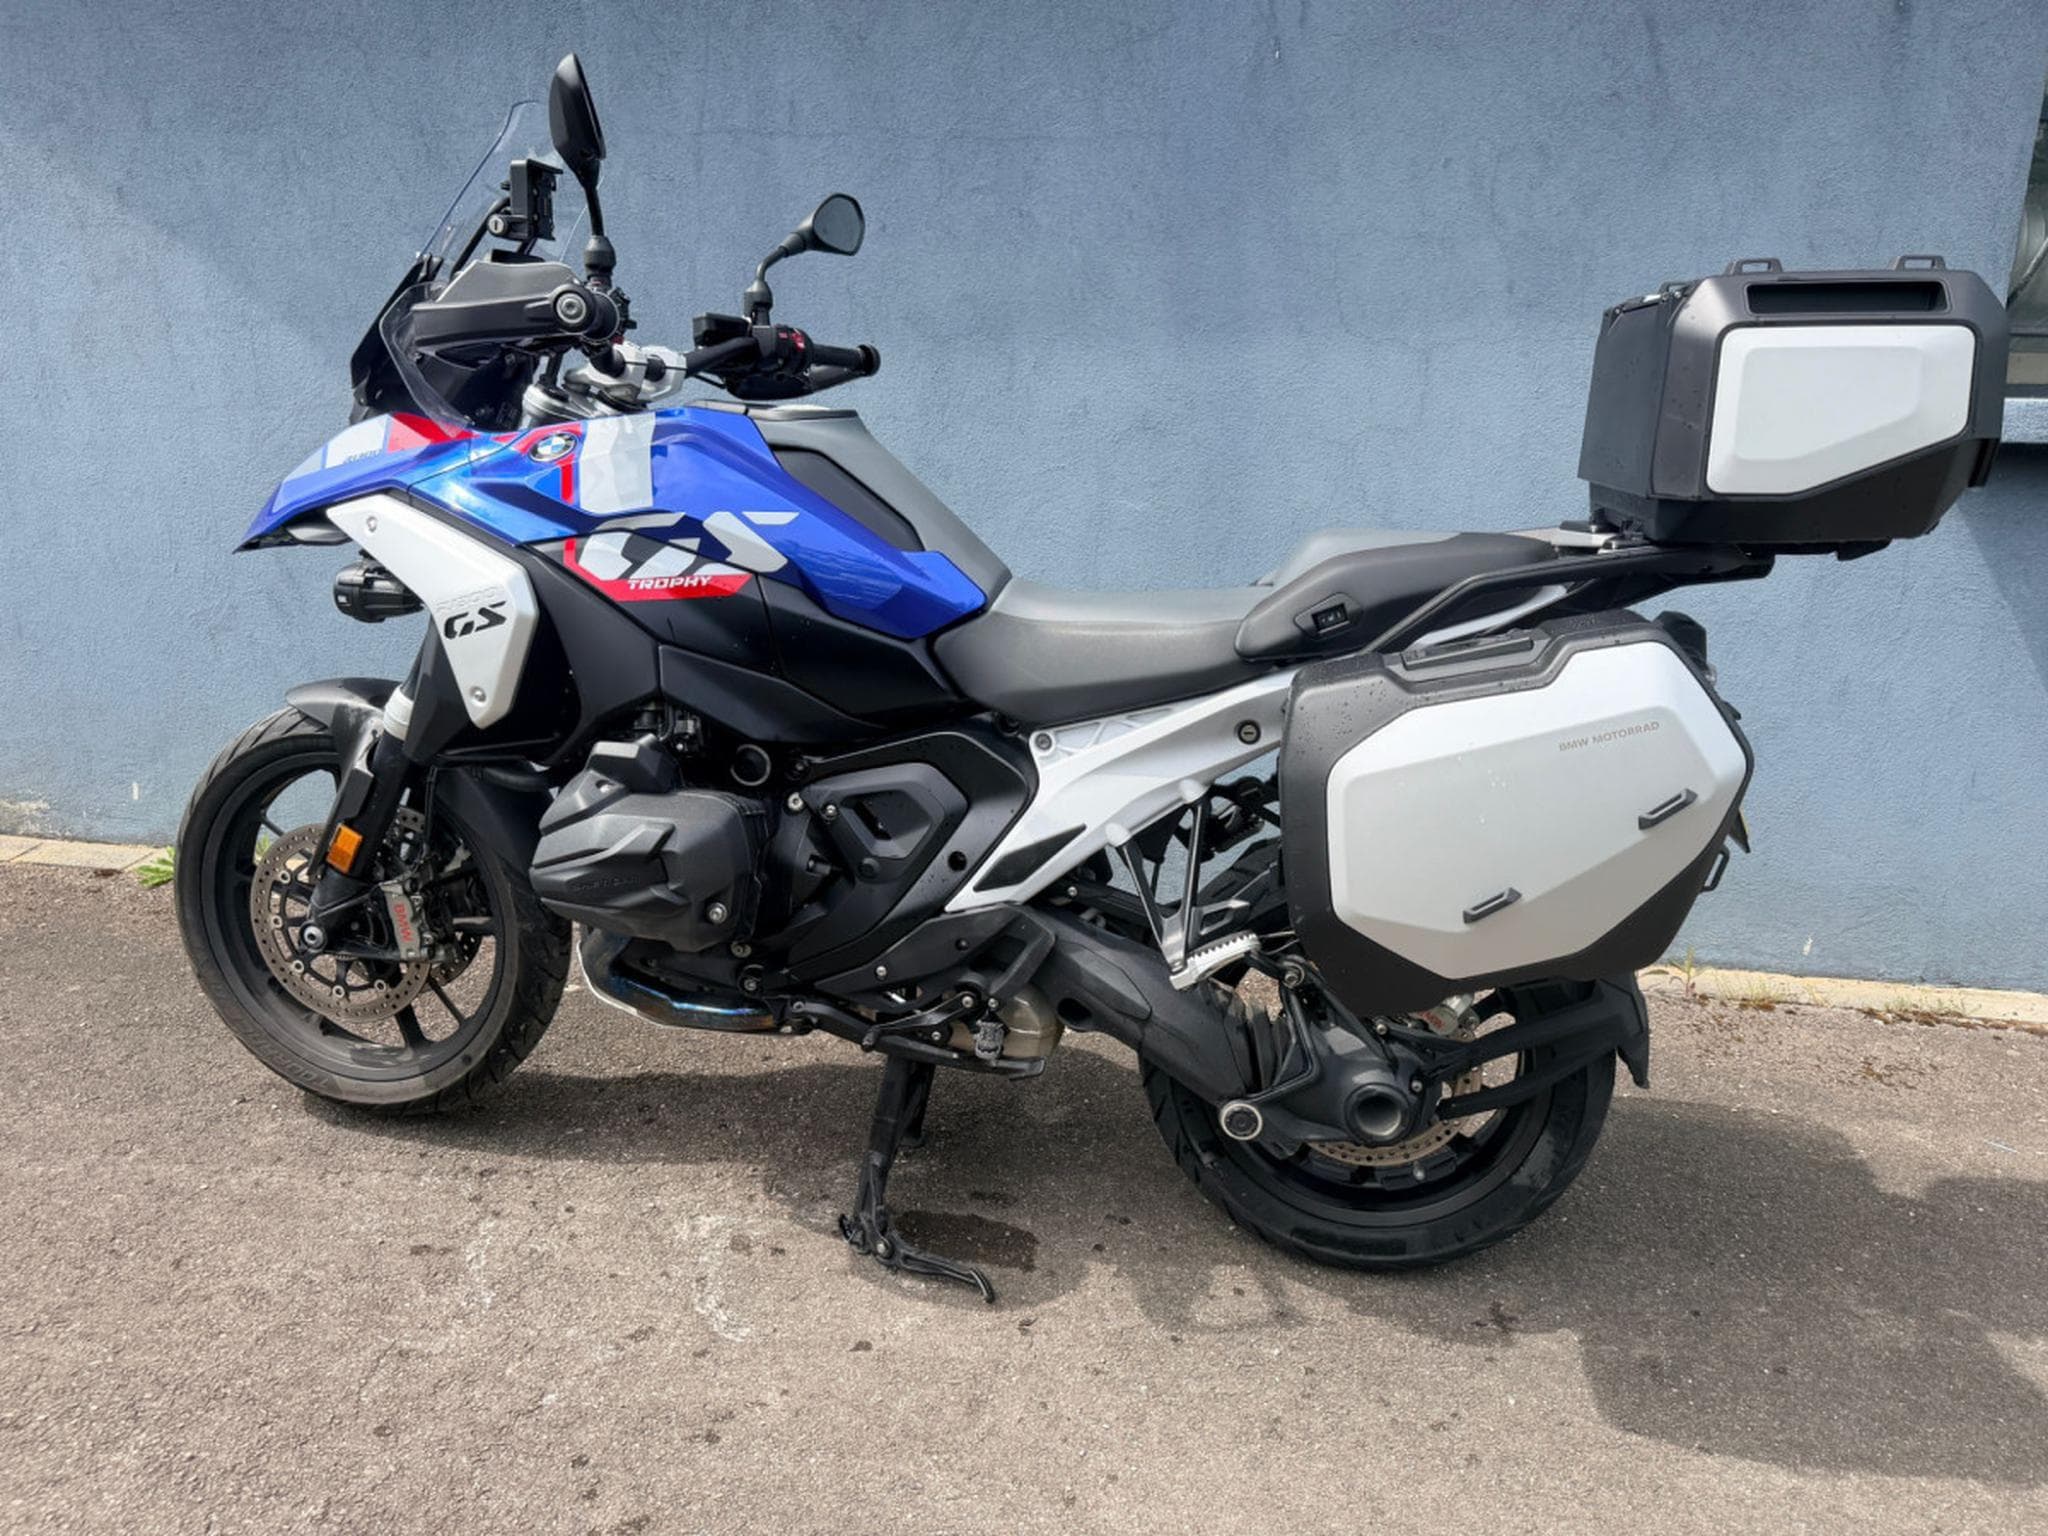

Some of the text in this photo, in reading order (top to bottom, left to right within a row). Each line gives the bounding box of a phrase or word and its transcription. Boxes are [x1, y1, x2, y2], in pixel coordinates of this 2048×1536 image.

[577, 511, 800, 581] GS
[627, 575, 713, 590] TROPHY
[444, 600, 507, 640] GS
[1558, 720, 1660, 752] BMW MOTORRAD
[393, 902, 415, 943] BMW
